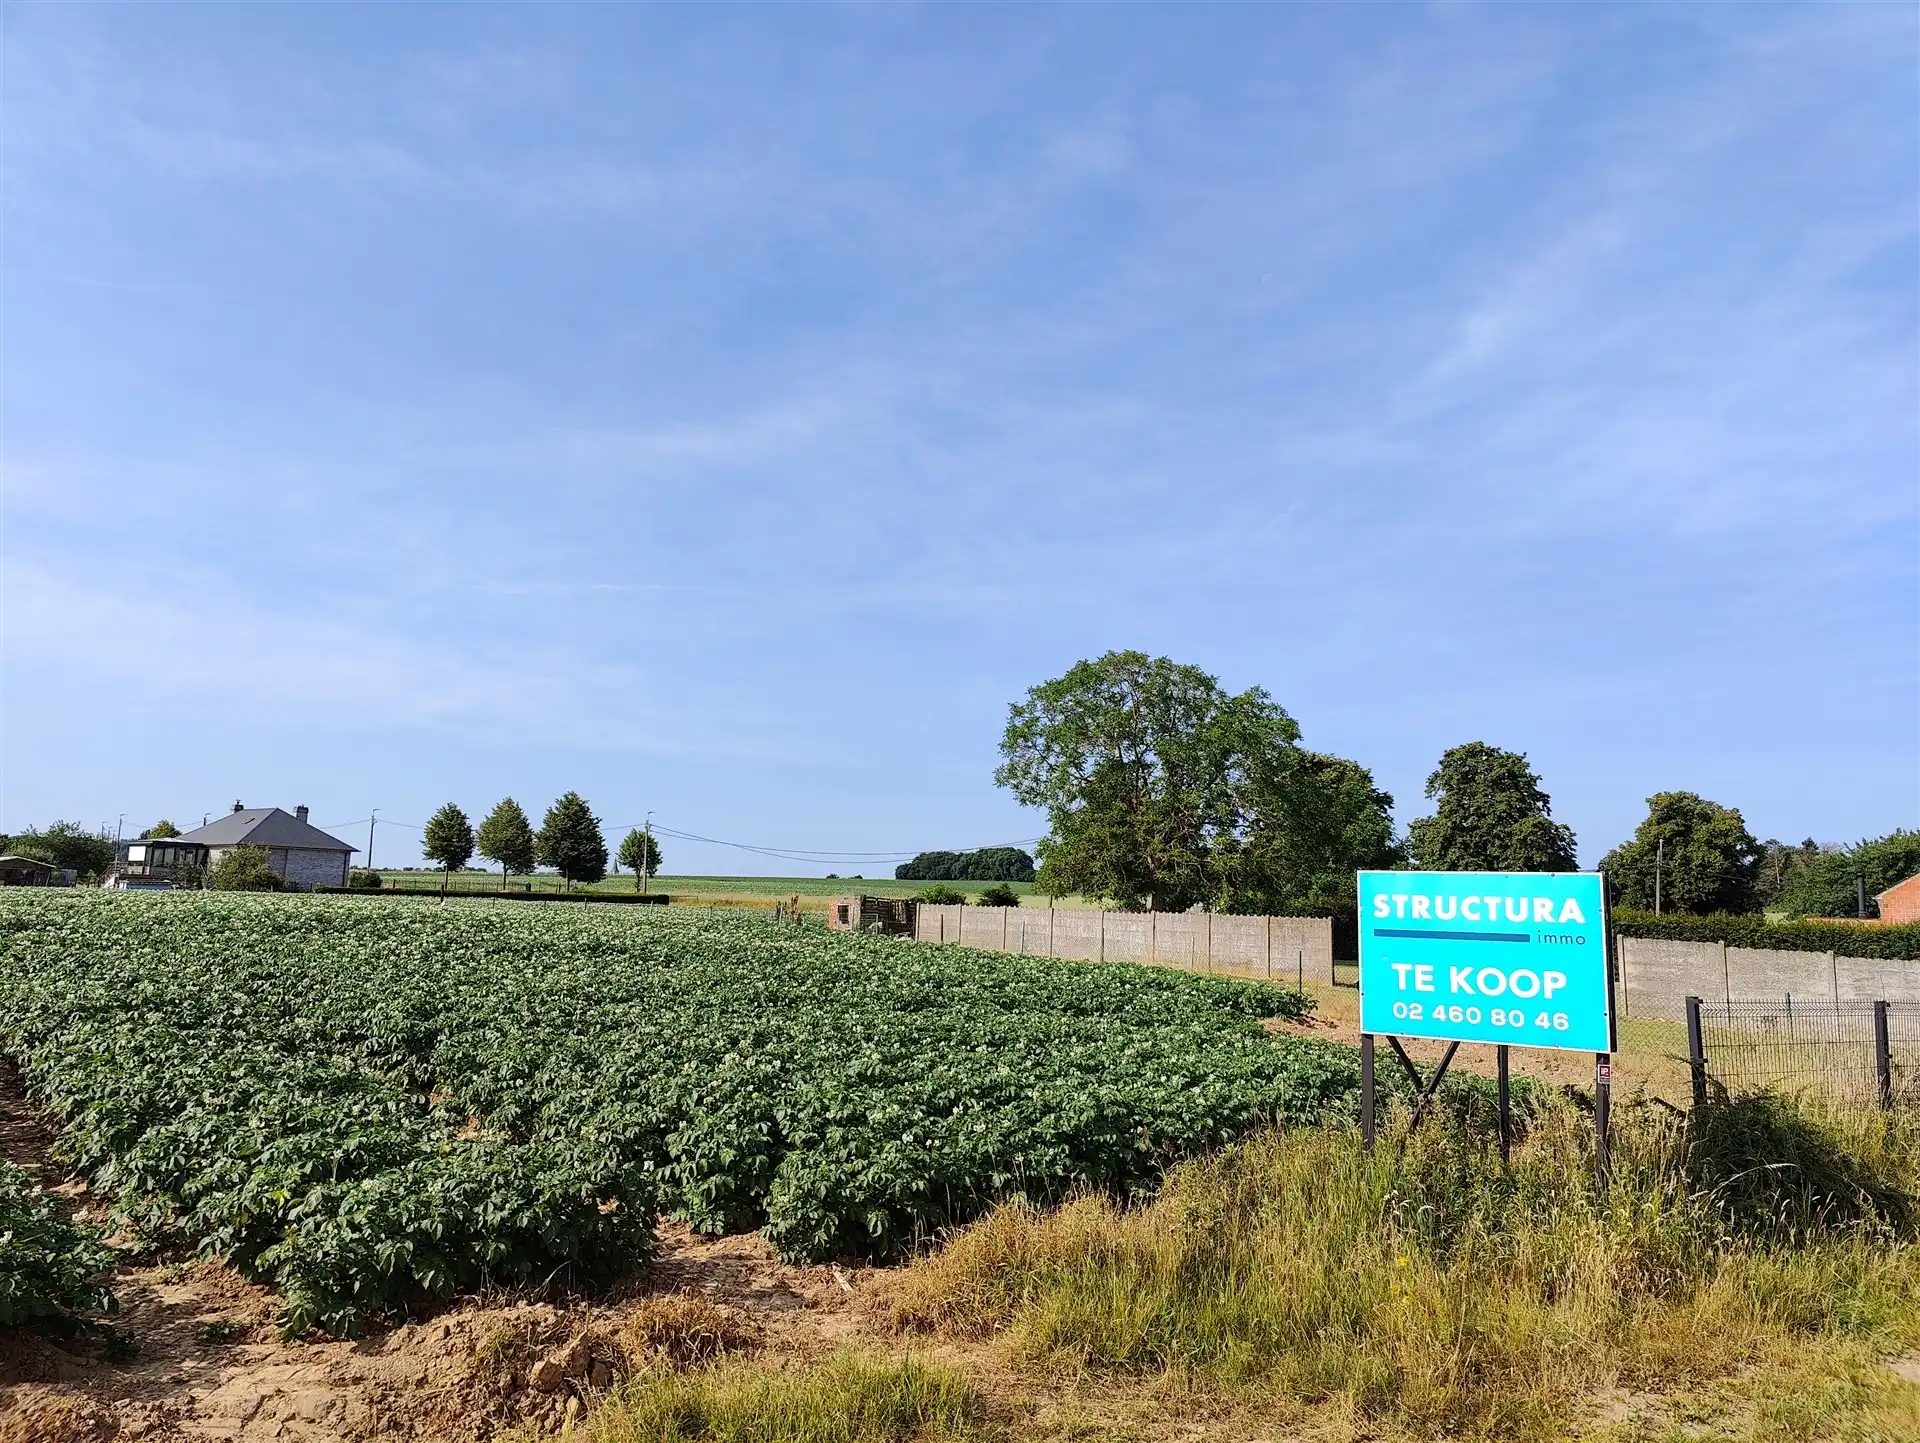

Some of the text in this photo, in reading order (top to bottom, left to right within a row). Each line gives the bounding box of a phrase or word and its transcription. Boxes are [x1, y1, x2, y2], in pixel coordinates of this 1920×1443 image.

[1374, 894, 1585, 923] STRUCTURA
[1538, 930, 1585, 945] immo
[1392, 964, 1566, 998] TE KOOP
[1393, 1002, 1569, 1030] 02 460 80 46
